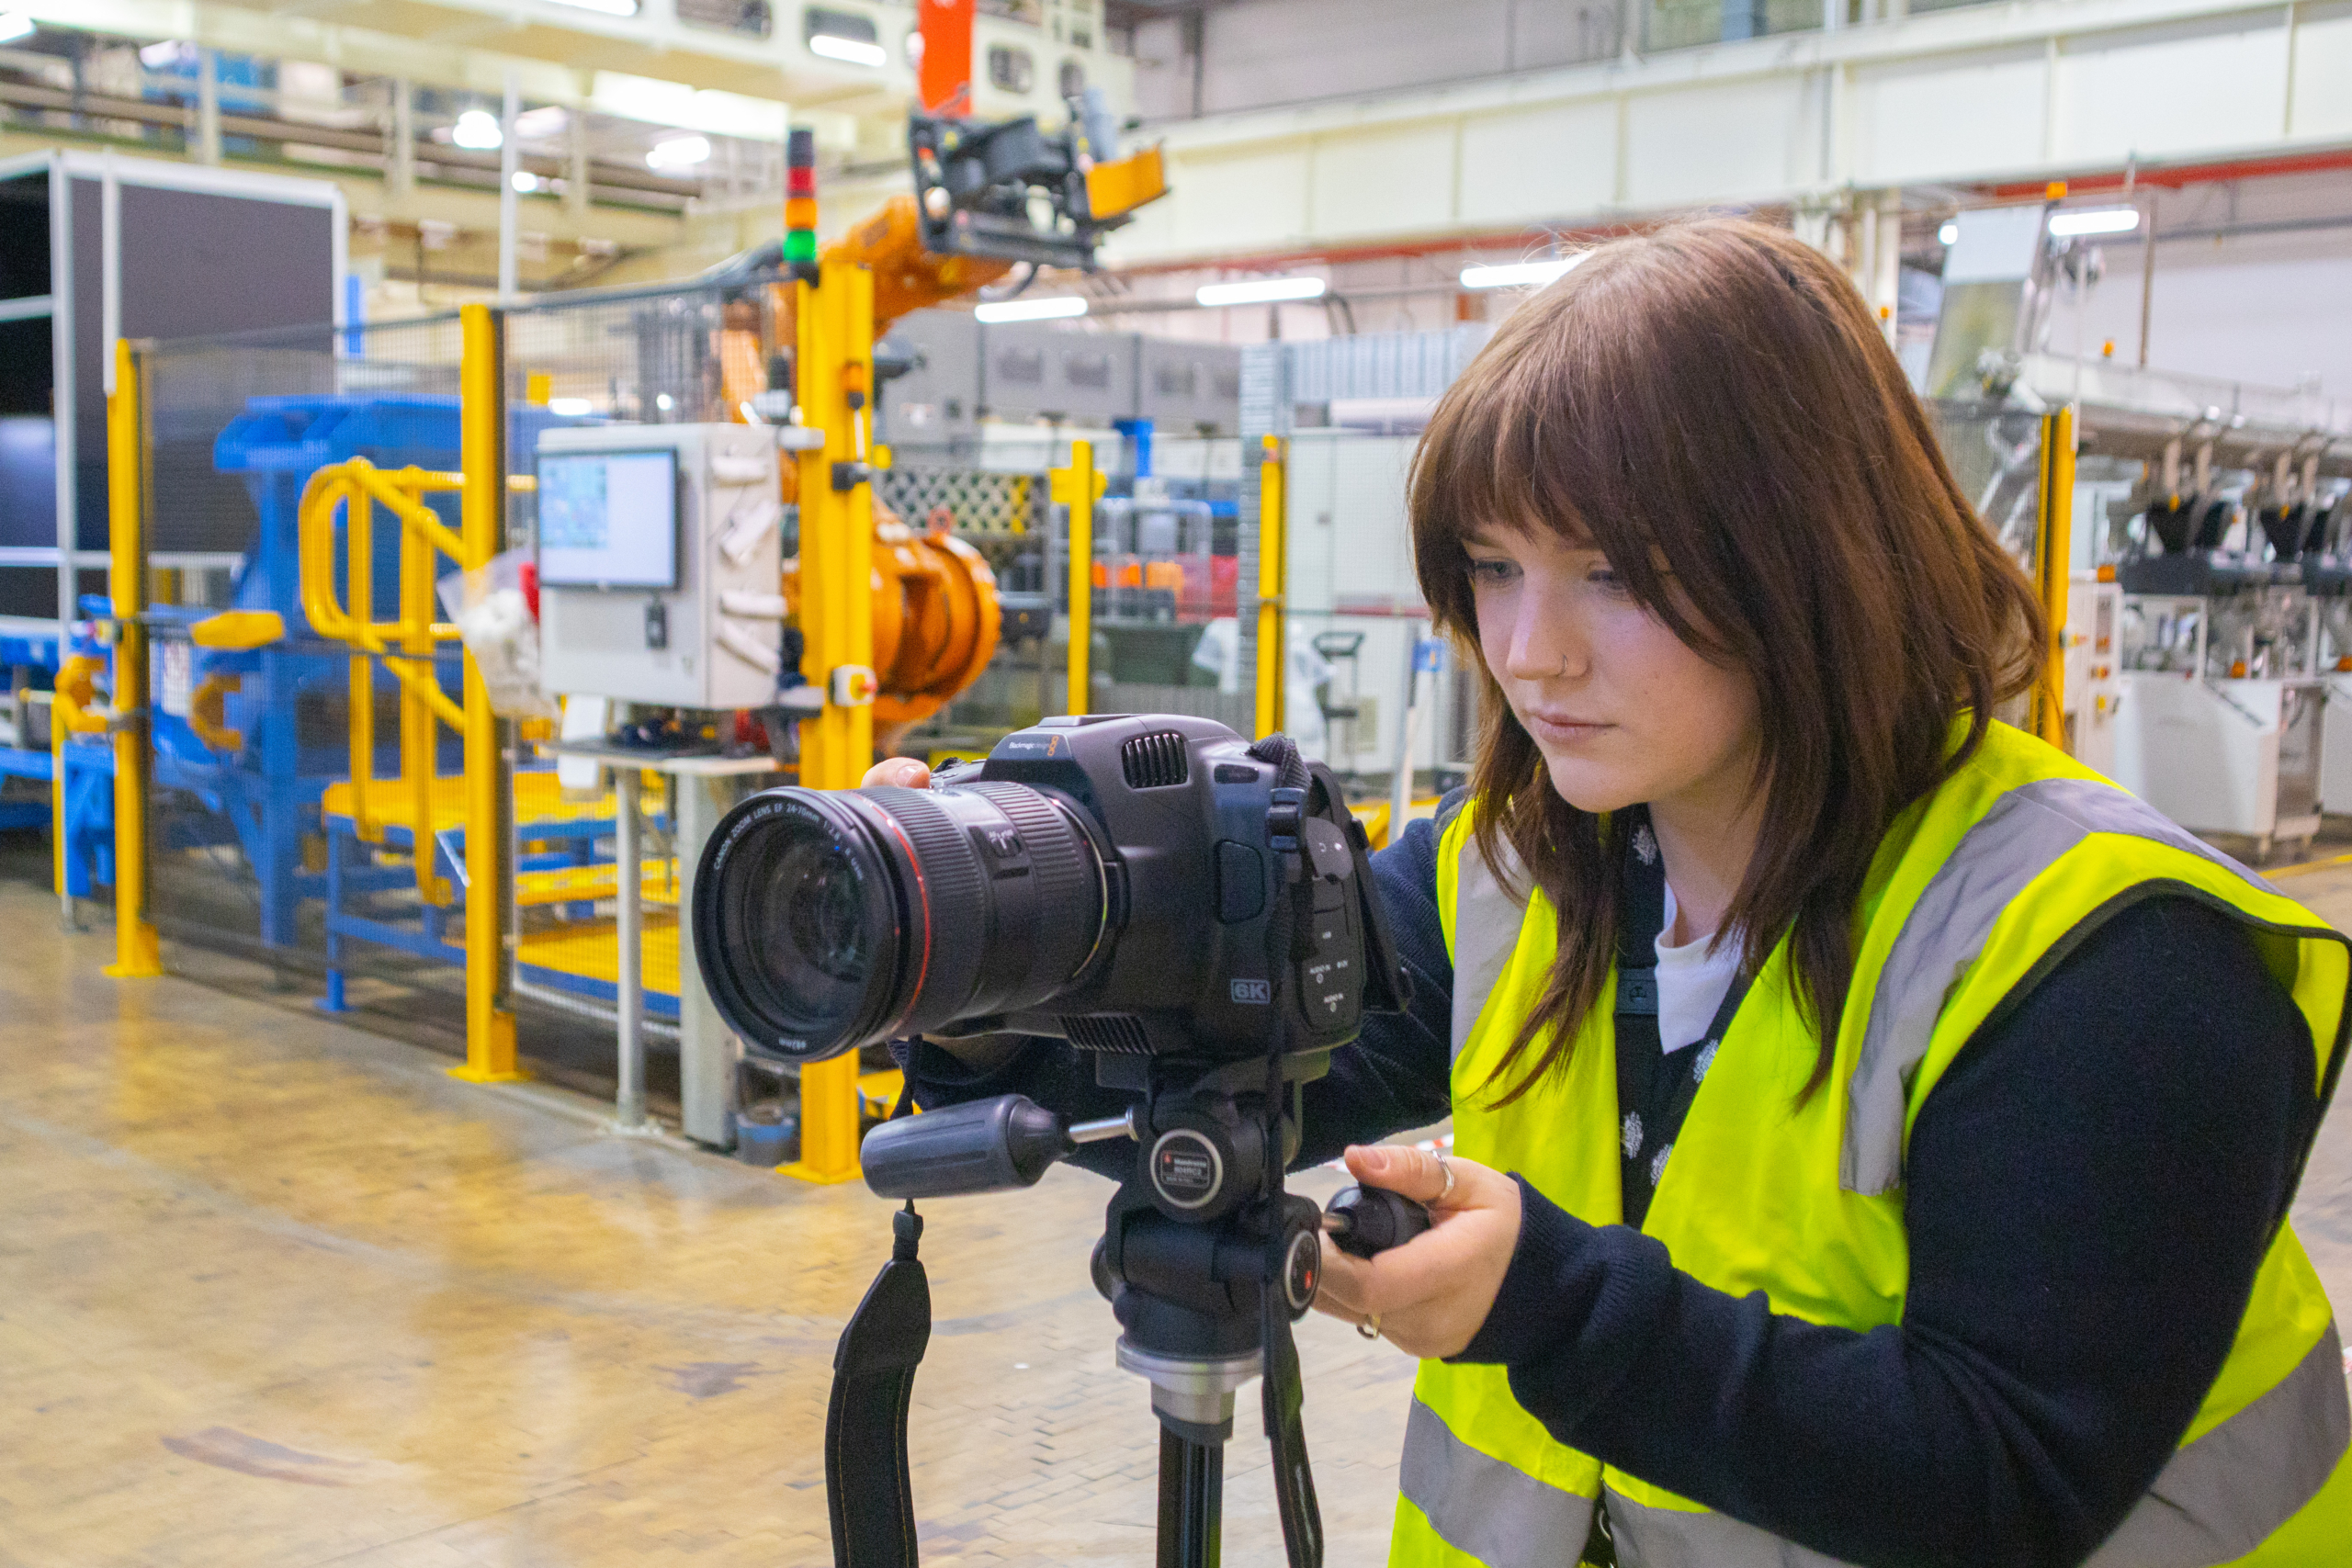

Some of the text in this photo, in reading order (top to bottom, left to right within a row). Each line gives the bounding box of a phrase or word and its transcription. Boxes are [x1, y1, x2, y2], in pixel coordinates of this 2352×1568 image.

[713, 837, 732, 870] CANON
[730, 815, 752, 838] ZOOM
[753, 805, 772, 819] LENS
[774, 803, 783, 813] EF
[786, 803, 820, 823] 24-70mm
[1235, 983, 1267, 999] 6K
